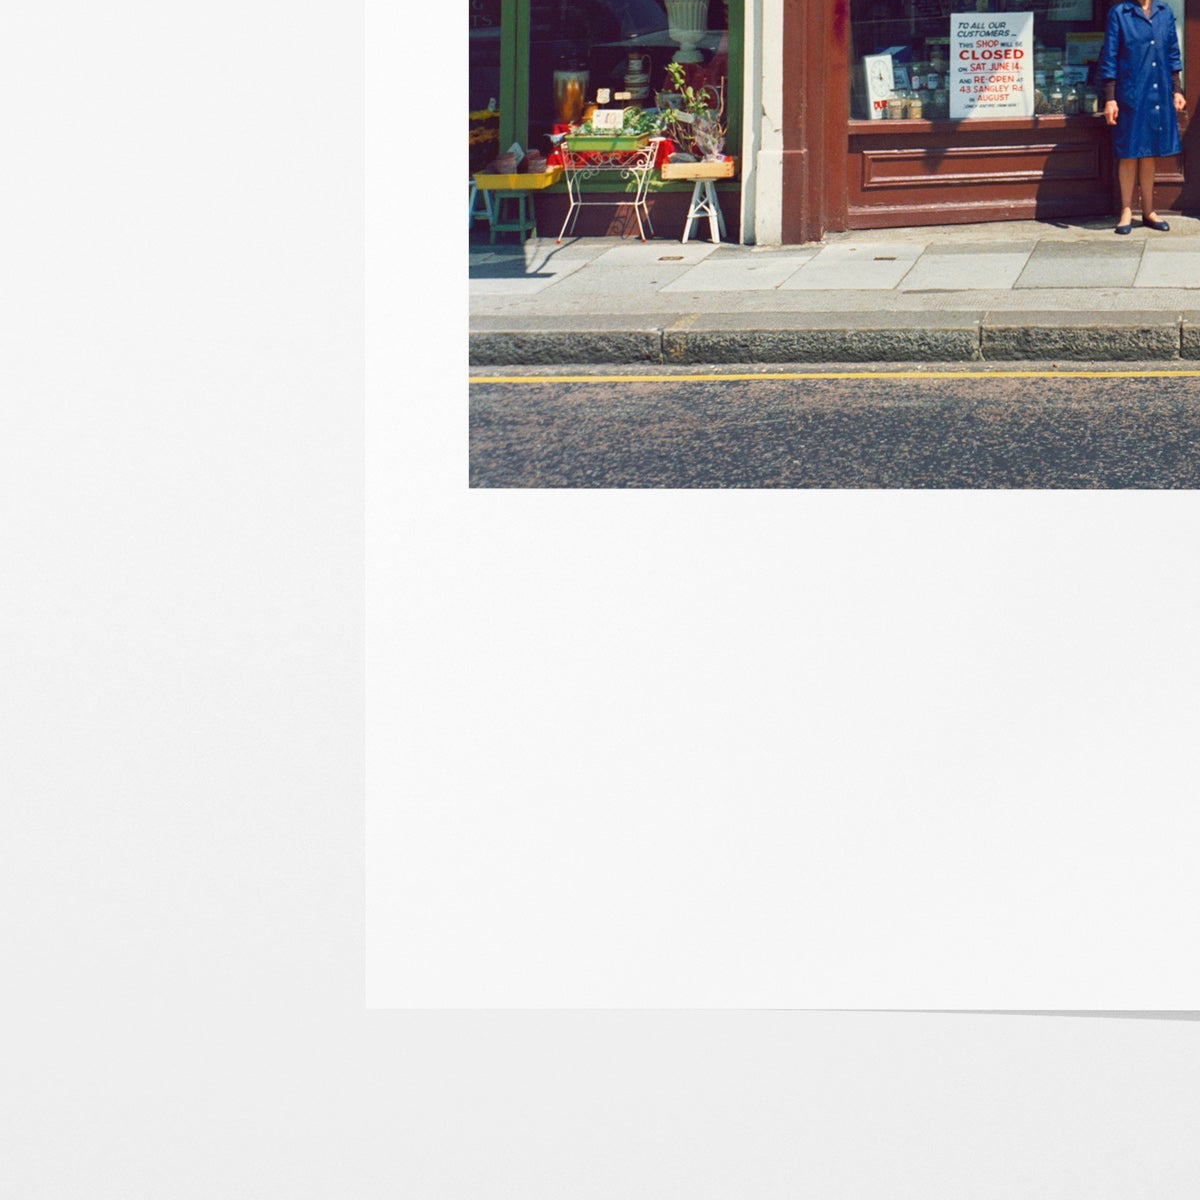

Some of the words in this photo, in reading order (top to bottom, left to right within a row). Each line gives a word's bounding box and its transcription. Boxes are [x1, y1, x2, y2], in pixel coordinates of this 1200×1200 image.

[976, 40, 999, 48] SHOP
[959, 49, 1024, 60] CLOSED
[970, 63, 986, 71] SAT
[989, 62, 1009, 71] JUNE
[974, 75, 1014, 83] RE-OPEN
[974, 85, 1009, 93] SANGLEY
[977, 94, 1010, 102] AUGUST
